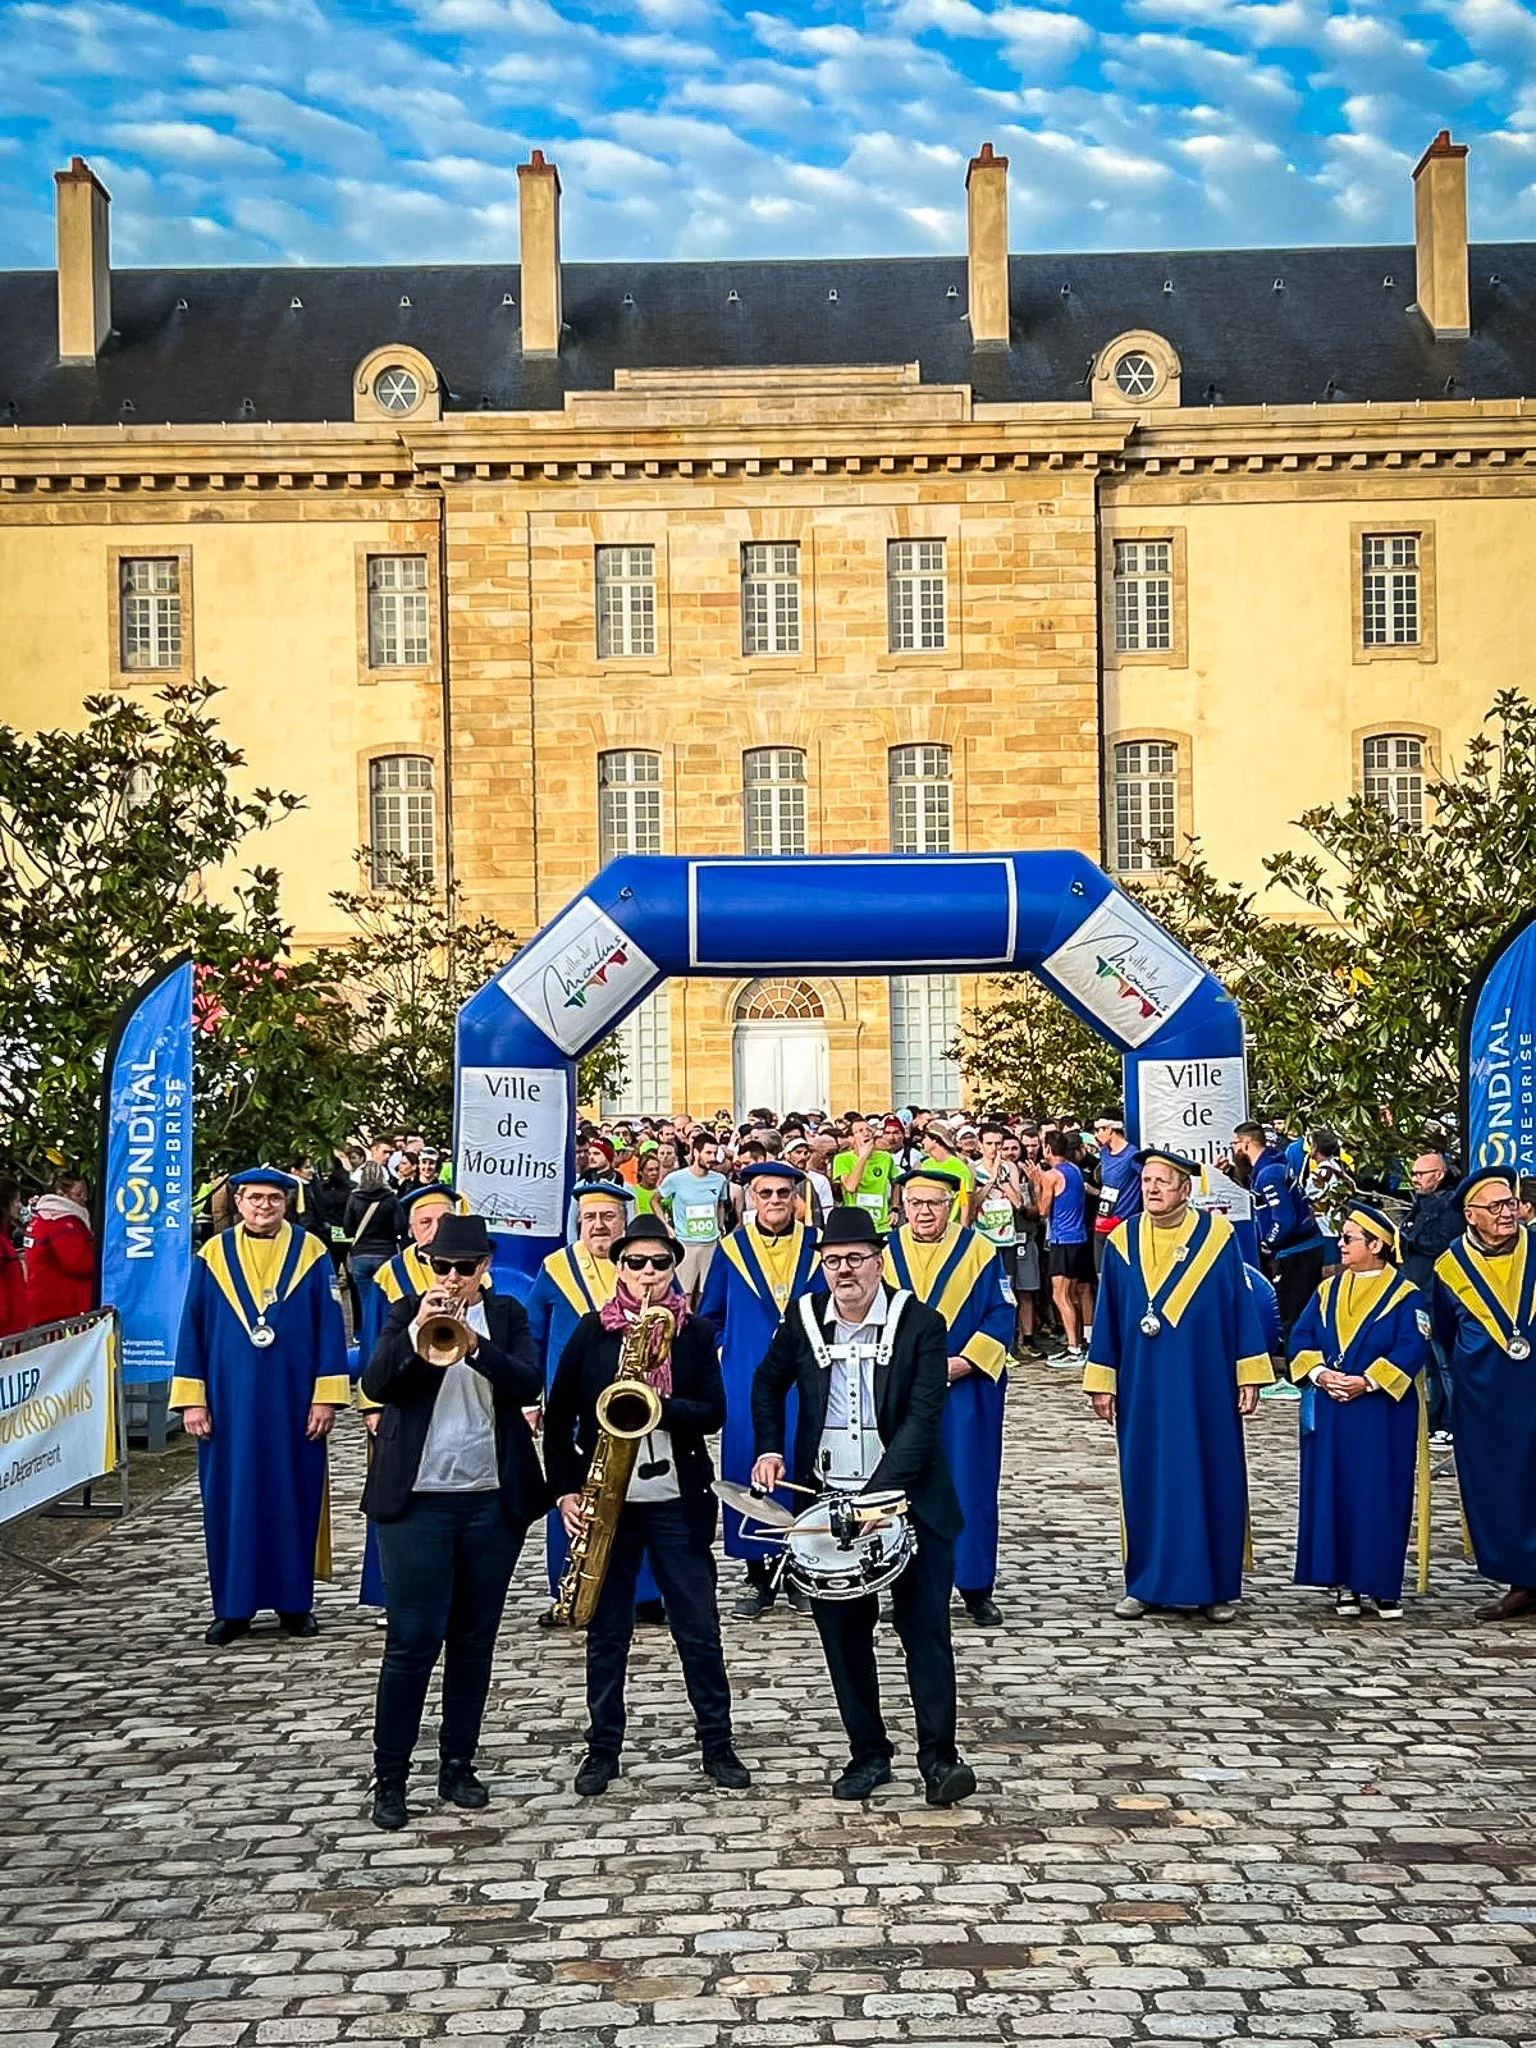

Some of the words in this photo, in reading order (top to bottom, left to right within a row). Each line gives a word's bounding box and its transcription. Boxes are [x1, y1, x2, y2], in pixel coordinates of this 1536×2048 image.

[1066, 934, 1170, 1012] Moulins
[484, 1073, 541, 1102] Ville
[1167, 1063, 1222, 1089] Ville
[1479, 1007, 1517, 1169] ONDIAL
[1182, 1102, 1214, 1128] de
[1519, 1033, 1535, 1179] PARE-BRISE
[497, 1114, 528, 1139] de
[165, 1078, 182, 1229] PARE-BRISE
[462, 1150, 558, 1180] Moulins
[688, 1219, 714, 1232] 300
[985, 1211, 1011, 1225] 332
[0, 1367, 41, 1411] LLIER
